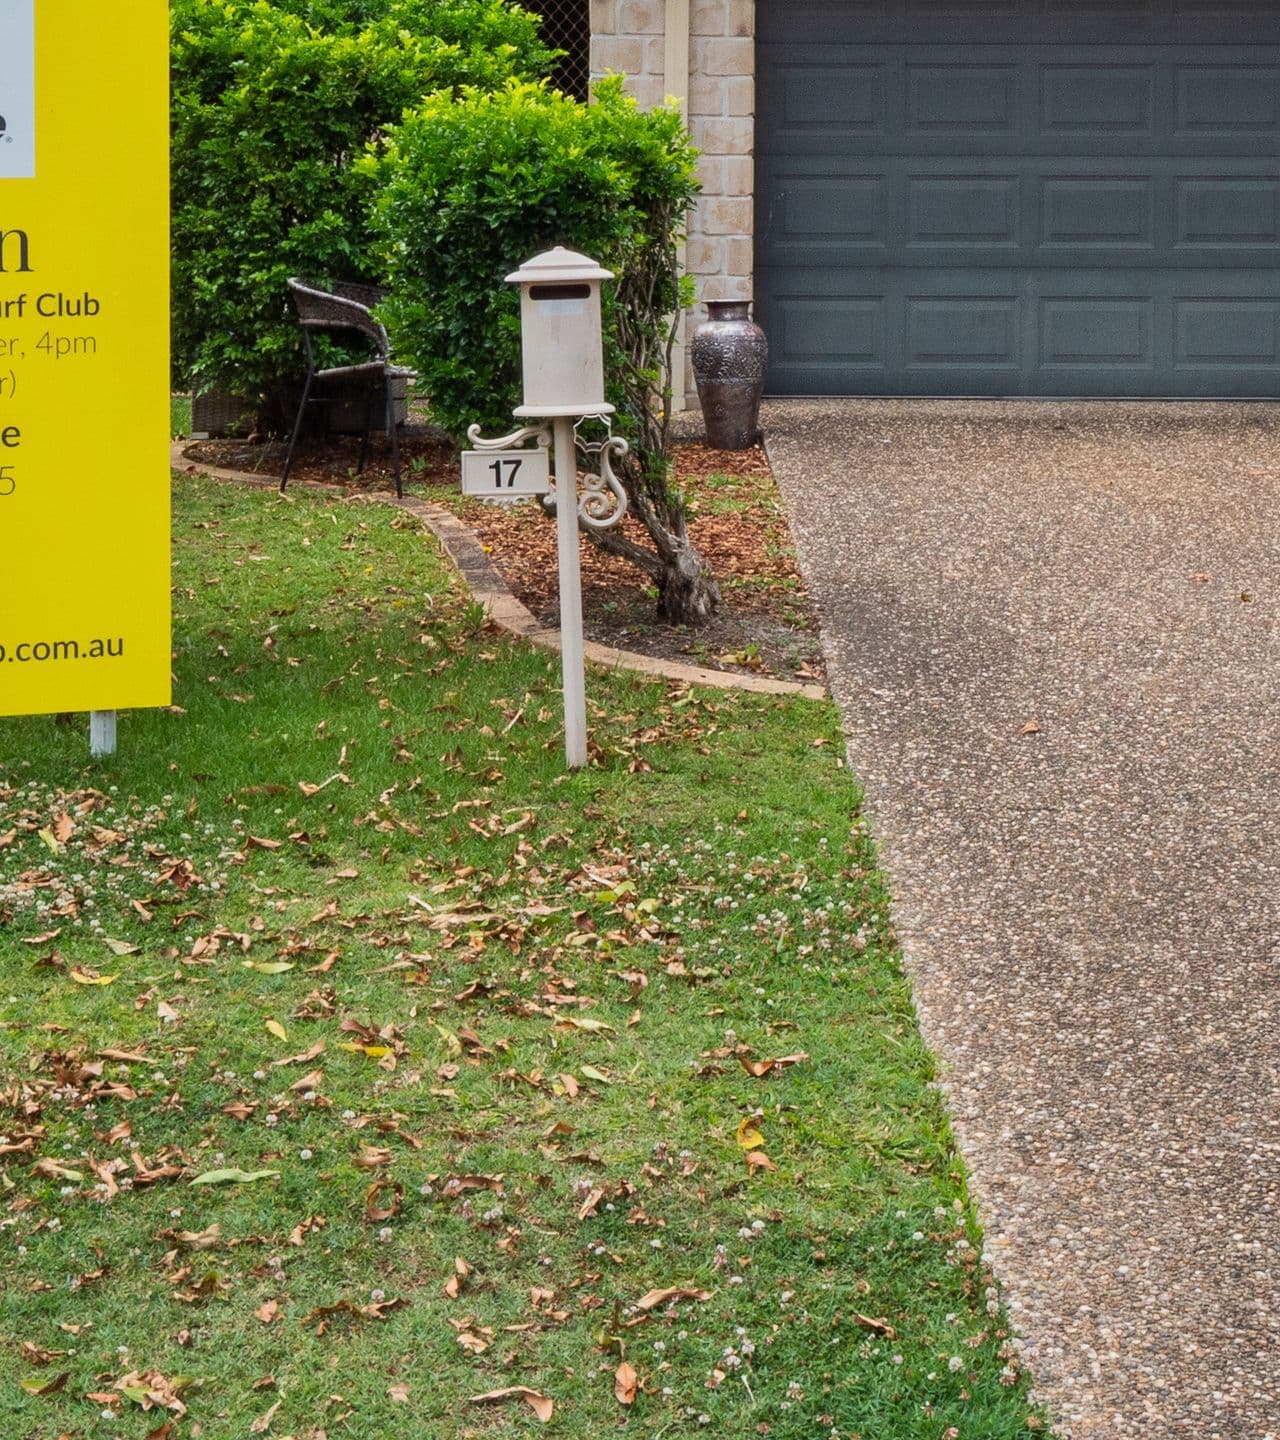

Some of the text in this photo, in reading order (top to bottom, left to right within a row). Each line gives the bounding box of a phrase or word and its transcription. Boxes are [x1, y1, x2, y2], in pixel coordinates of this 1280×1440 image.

[35, 291, 101, 318] Club
[35, 331, 97, 360] 4pm
[488, 458, 523, 488] 17
